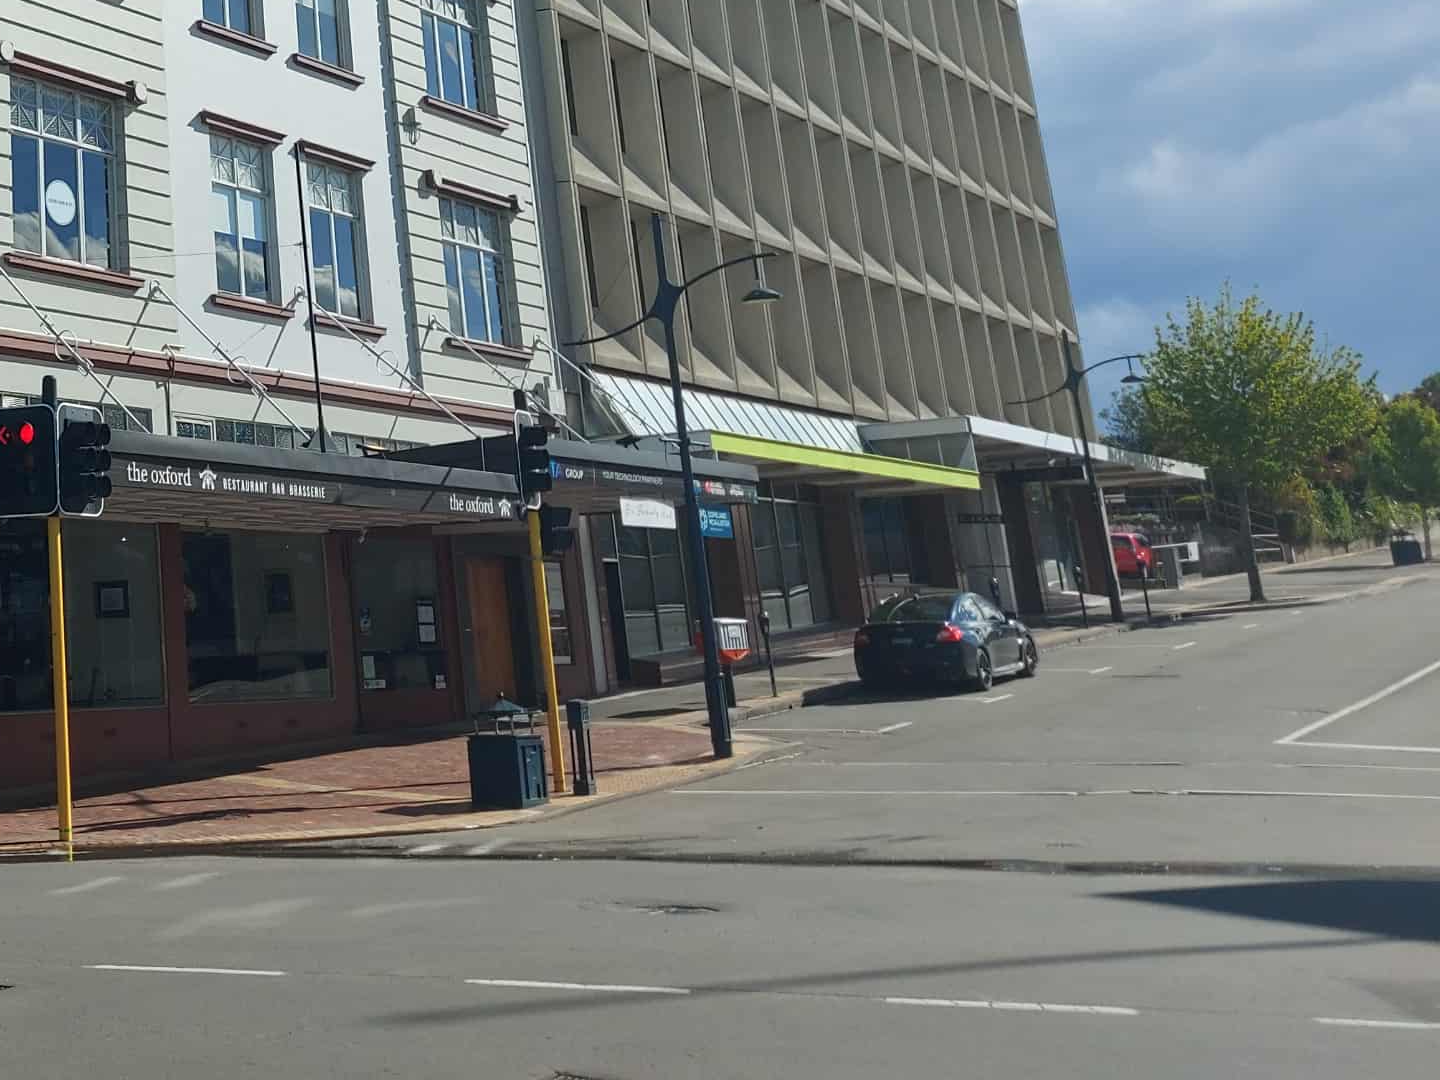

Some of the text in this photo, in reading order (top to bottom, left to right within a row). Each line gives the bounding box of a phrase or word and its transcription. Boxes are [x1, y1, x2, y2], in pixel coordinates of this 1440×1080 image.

[127, 461, 326, 499] the oxford RESTAURANT BAR BRASSERIE
[565, 468, 584, 480] GROUP
[449, 493, 495, 514] the oxford
